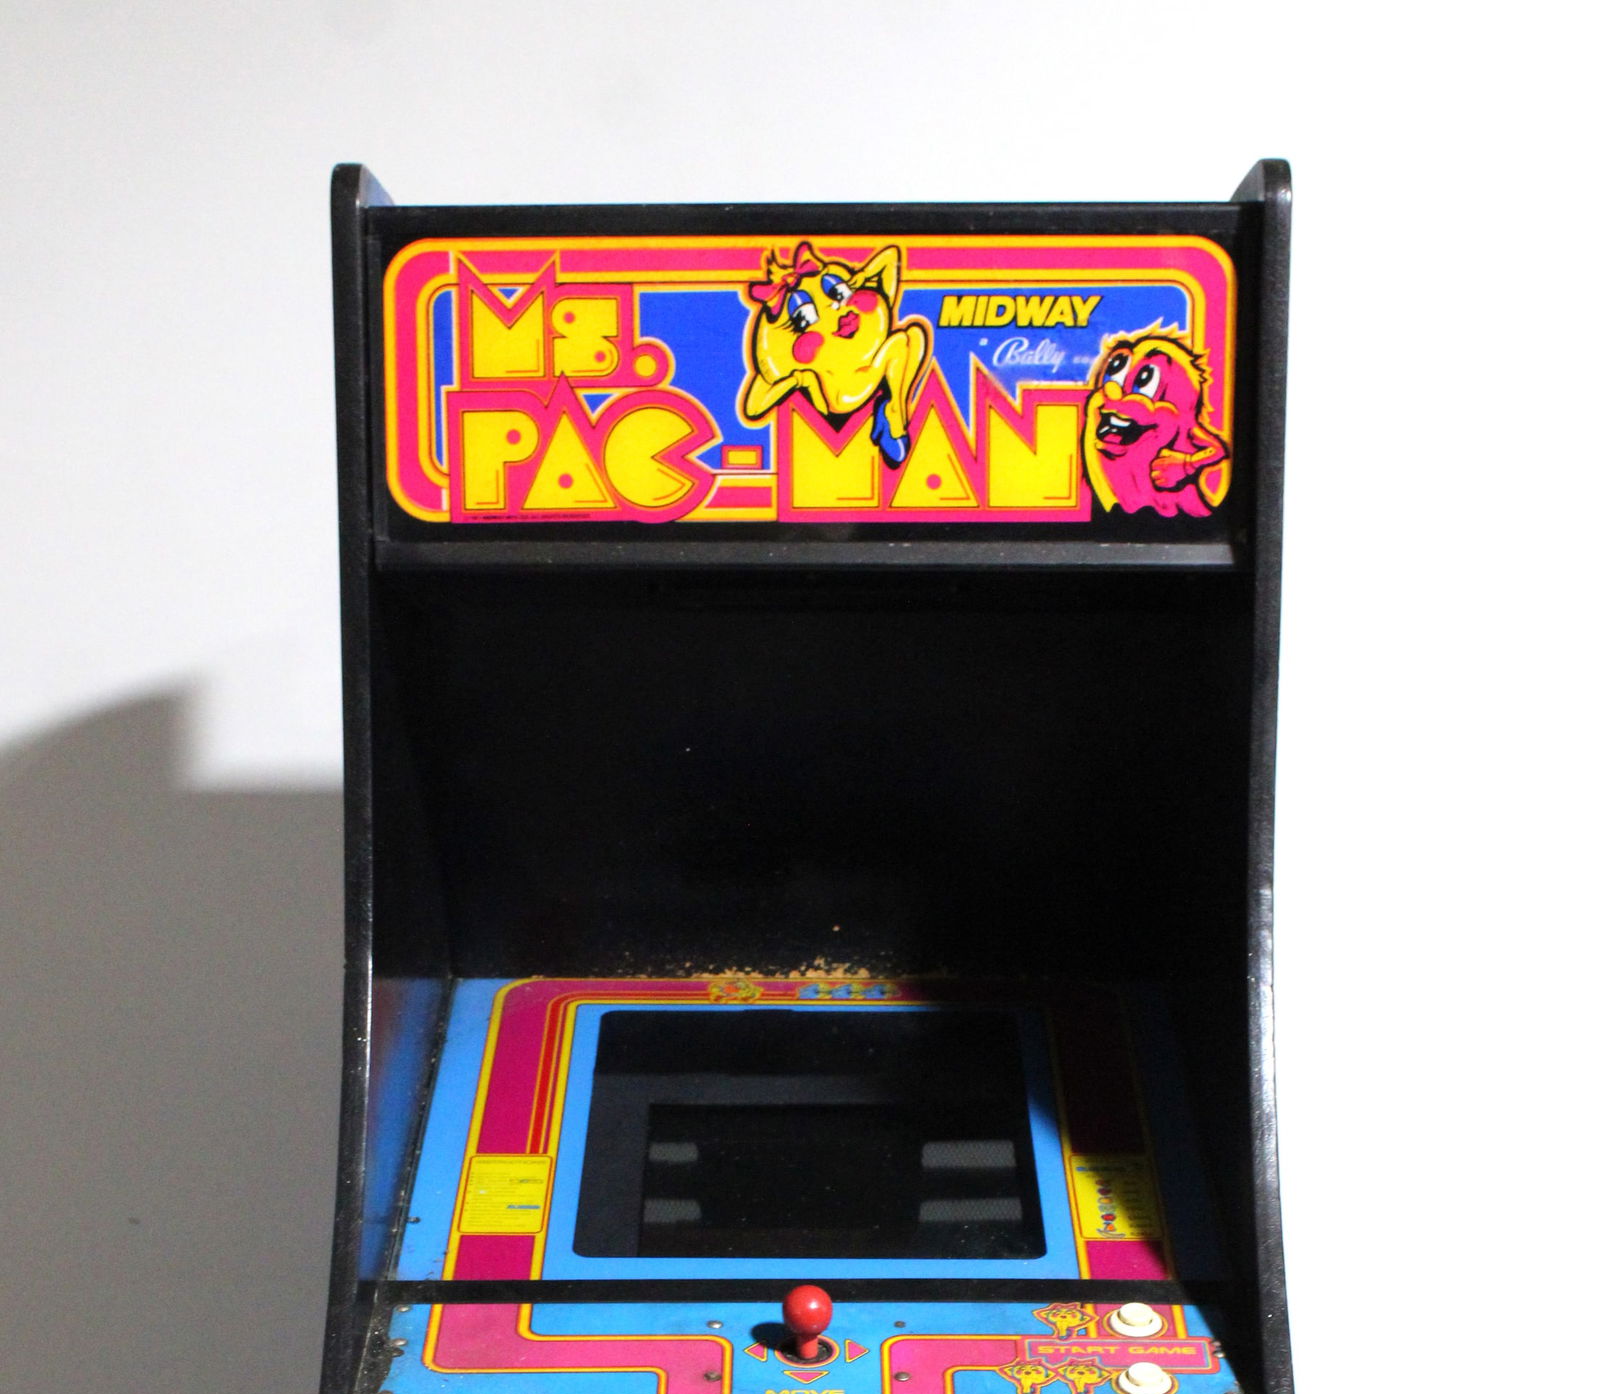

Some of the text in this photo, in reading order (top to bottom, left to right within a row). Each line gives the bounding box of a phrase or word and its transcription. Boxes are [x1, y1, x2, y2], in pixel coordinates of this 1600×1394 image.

[937, 295, 1104, 328] MIDWAY
[992, 337, 1066, 373] Bally
[458, 397, 1084, 514] PAC-MAN
[1037, 1345, 1198, 1355] START GAME
